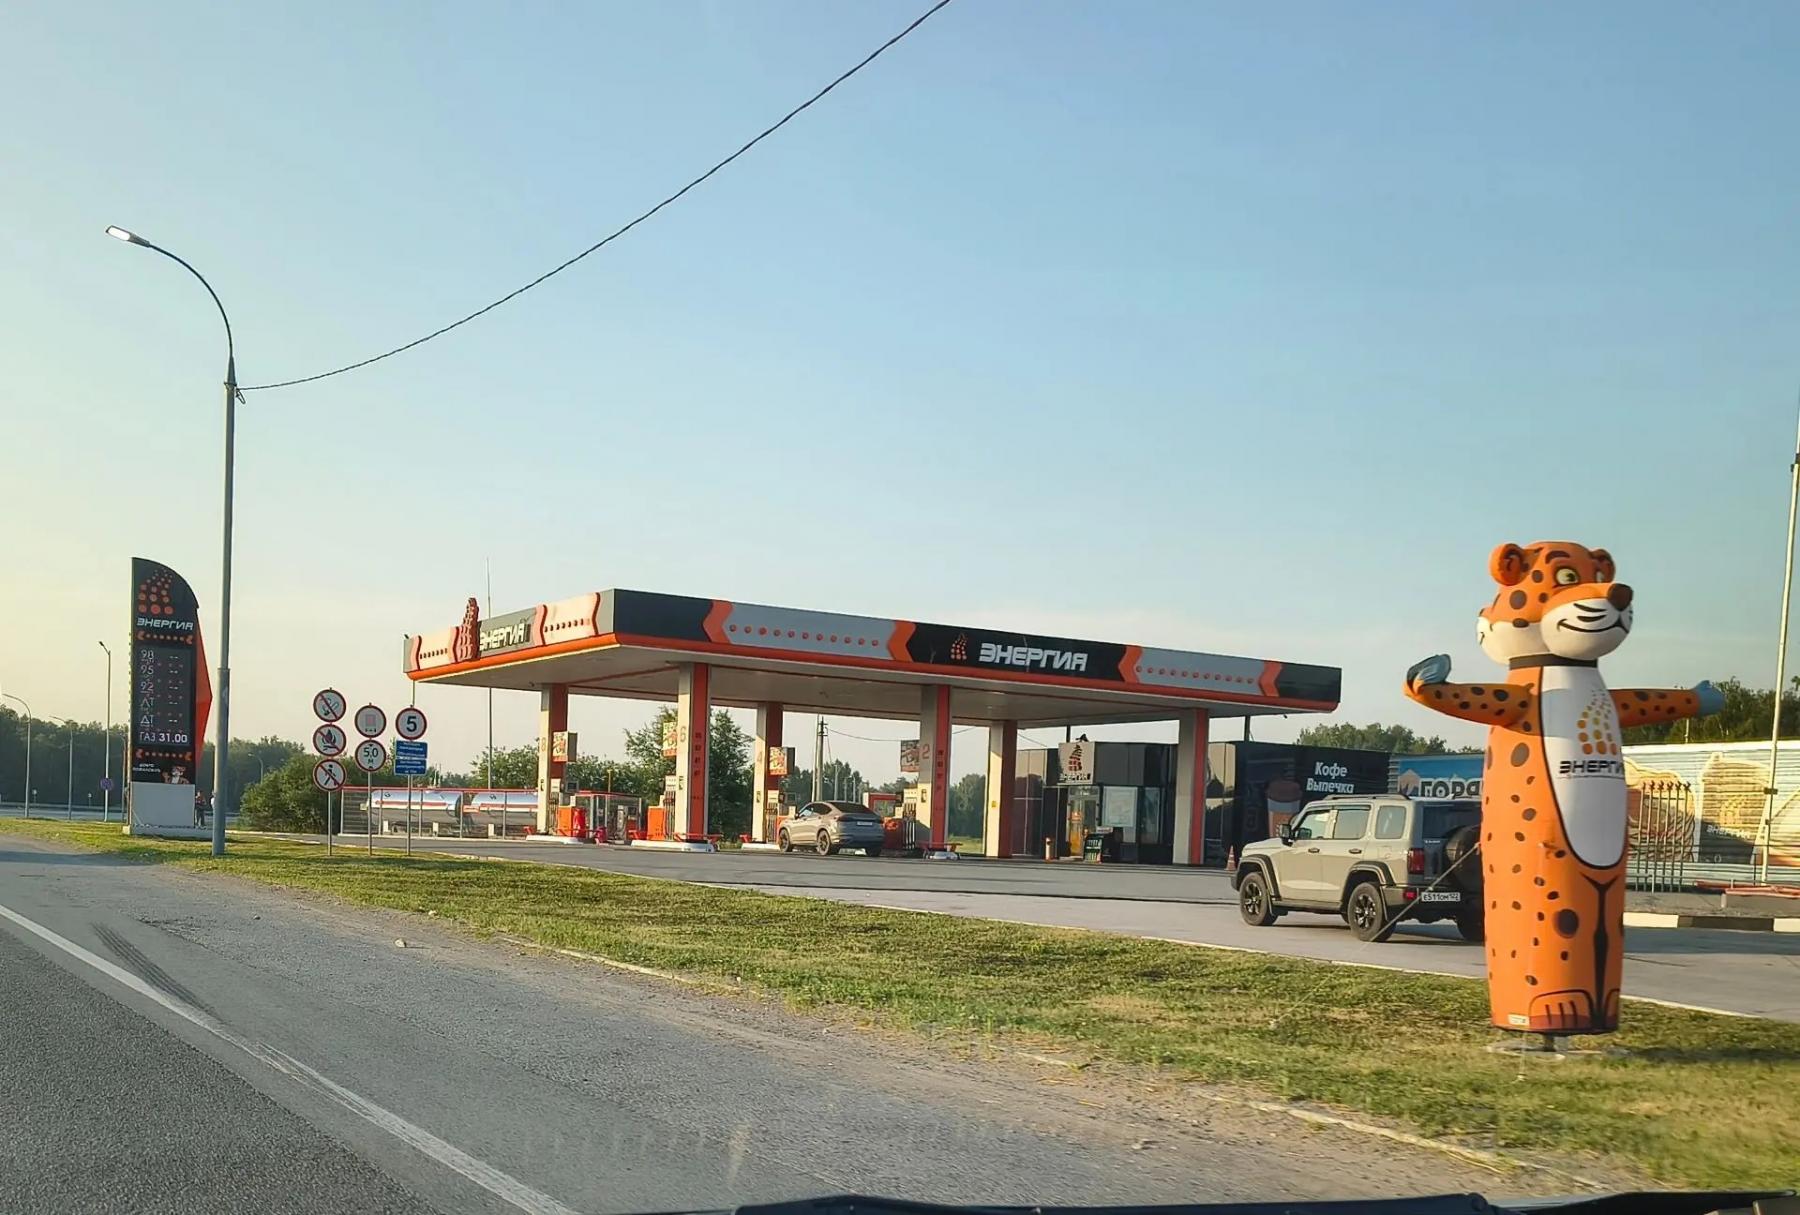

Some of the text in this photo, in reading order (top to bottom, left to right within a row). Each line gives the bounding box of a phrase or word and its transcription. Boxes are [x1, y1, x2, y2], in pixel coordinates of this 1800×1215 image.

[136, 617, 194, 631] ЭНЕРГИЯ
[140, 649, 155, 660] 98
[978, 642, 1089, 672] ЭНЕРГИЯ
[140, 664, 154, 675] 95
[140, 681, 154, 692] 92
[406, 715, 418, 732] 5
[139, 731, 188, 743] ГАЗ 31.00
[1314, 761, 1348, 780] Кофе
[1559, 760, 1624, 774] ЭНЕРГИ
[1306, 777, 1355, 794] Выпечка
